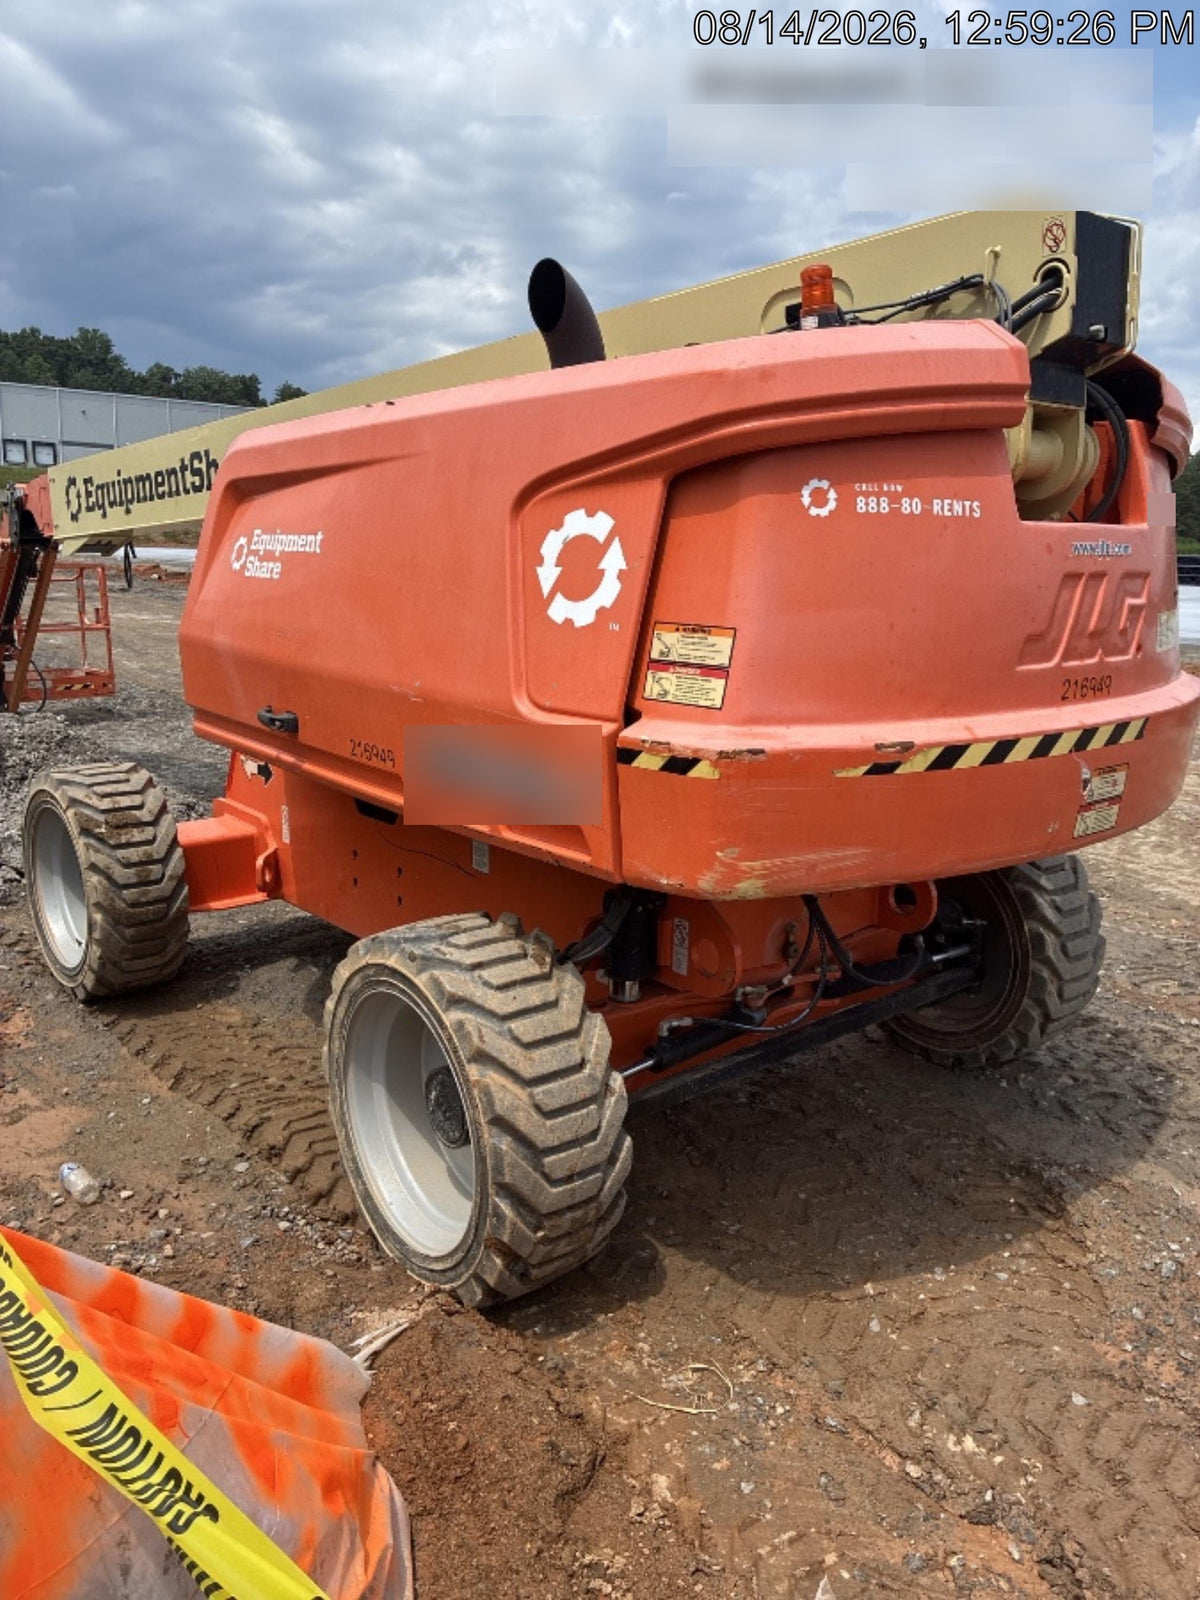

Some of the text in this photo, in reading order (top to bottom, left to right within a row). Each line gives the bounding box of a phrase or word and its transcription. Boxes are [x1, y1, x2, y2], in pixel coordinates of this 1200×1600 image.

[244, 554, 282, 580] Share
[249, 528, 324, 557] Equipment
[1016, 571, 1152, 670] JLG
[1060, 675, 1113, 701] 216949
[0, 1277, 79, 1397] CUIDAD
[65, 1402, 220, 1536] CAUTION
